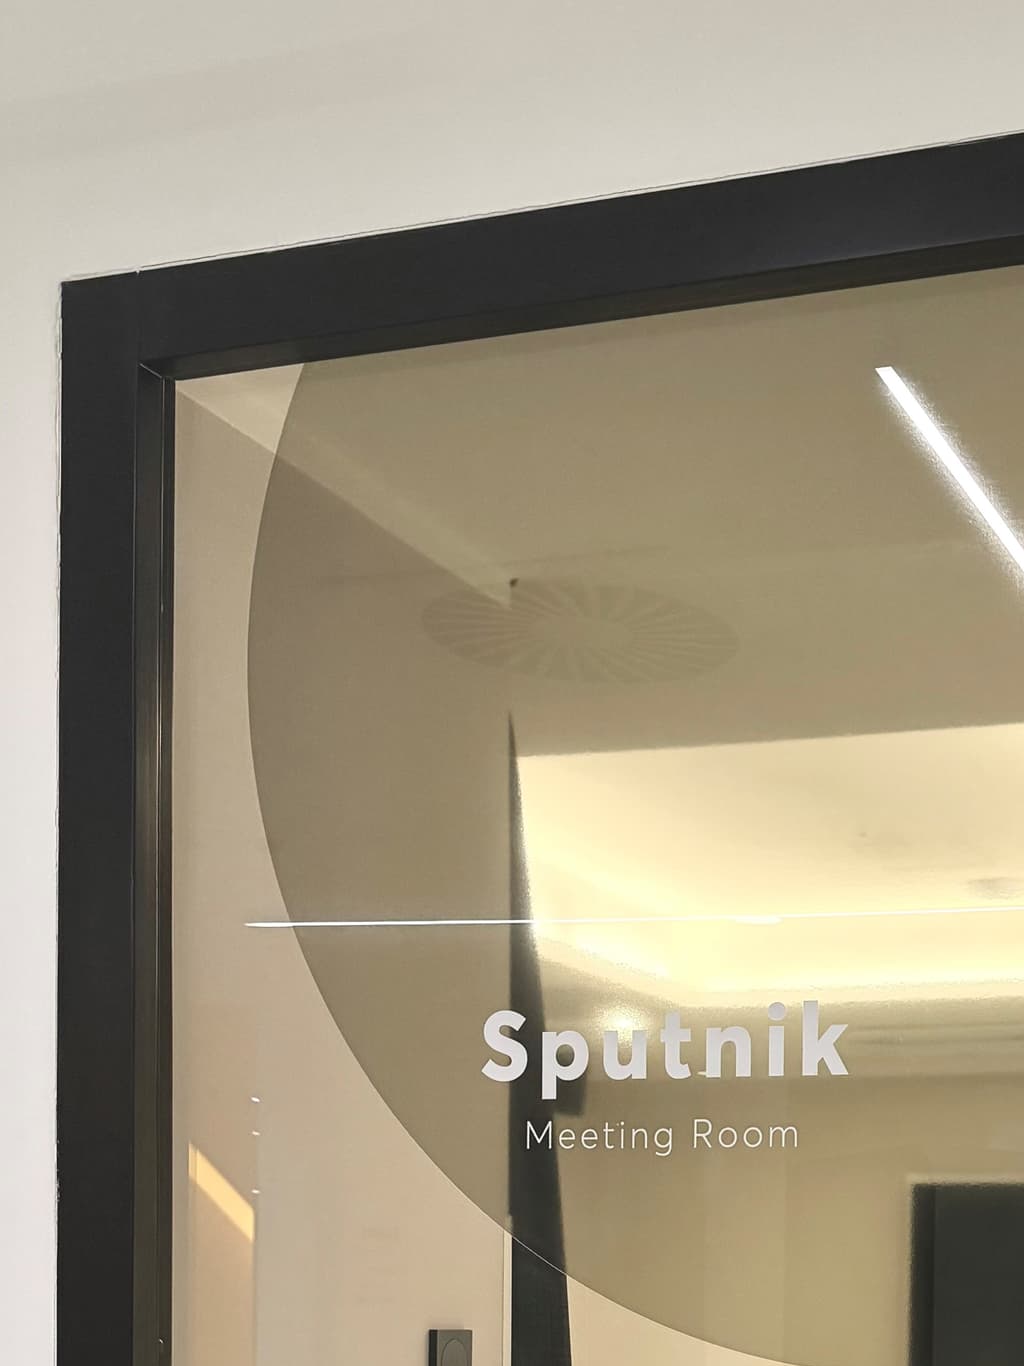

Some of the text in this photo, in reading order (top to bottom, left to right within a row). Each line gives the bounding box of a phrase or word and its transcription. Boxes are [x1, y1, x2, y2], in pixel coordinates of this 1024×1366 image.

[481, 1000, 849, 1100] Sputnik
[525, 1118, 799, 1157] Meeting Room
